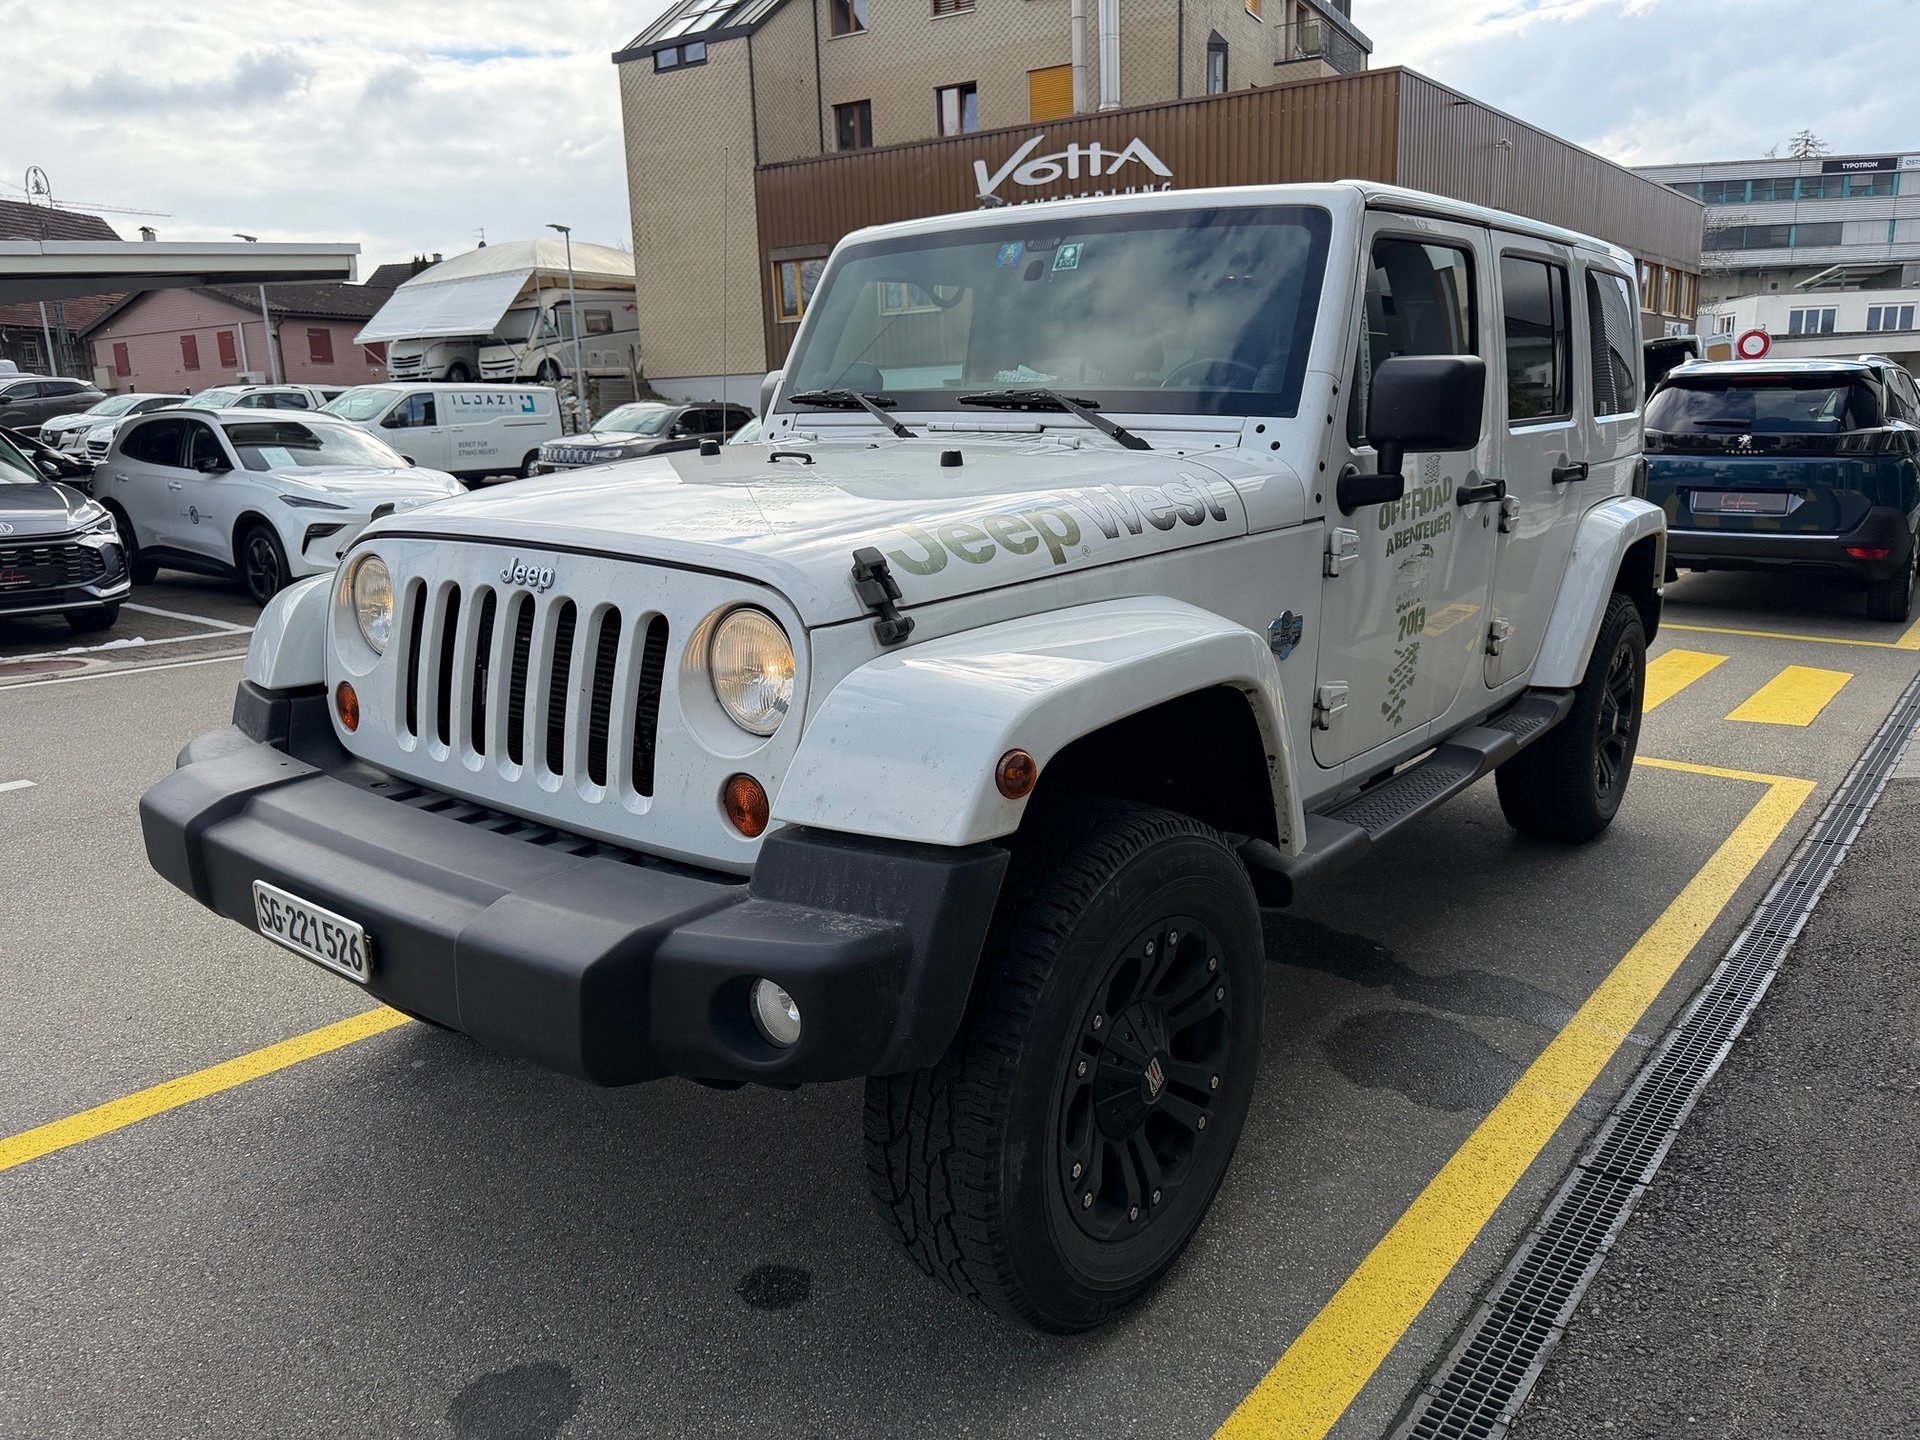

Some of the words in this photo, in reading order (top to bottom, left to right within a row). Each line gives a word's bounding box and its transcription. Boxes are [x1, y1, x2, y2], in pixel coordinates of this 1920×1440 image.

[1842, 161, 1878, 169] TYPOTRON
[886, 505, 1081, 576] Jeep
[1050, 471, 1228, 540] West
[1378, 475, 1453, 532] OFFROAD
[1385, 511, 1452, 558] ABENTEUER
[500, 557, 556, 594] Jeep
[1398, 606, 1425, 642] 2013
